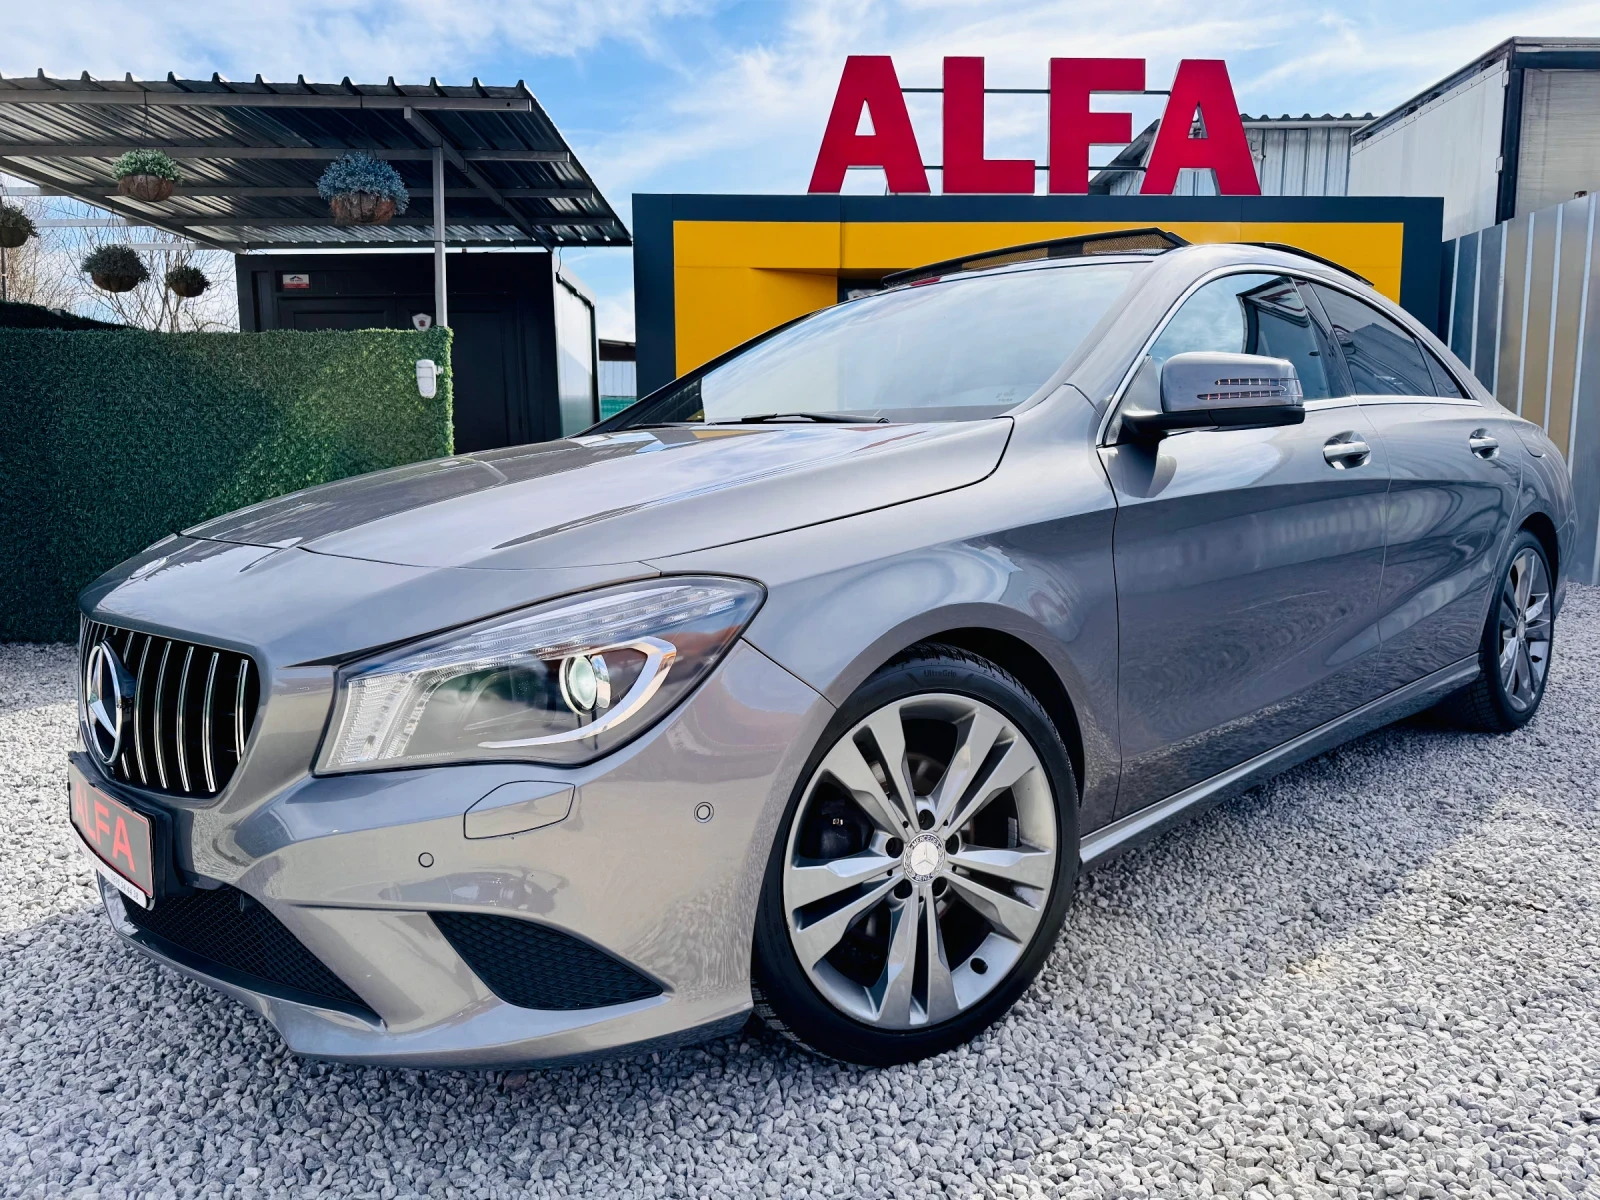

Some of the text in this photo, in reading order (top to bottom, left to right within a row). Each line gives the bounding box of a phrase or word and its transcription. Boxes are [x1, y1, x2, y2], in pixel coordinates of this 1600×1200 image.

[807, 55, 1261, 194] ALFA
[923, 669, 957, 678] UltraGrip
[75, 781, 136, 873] ALFA
